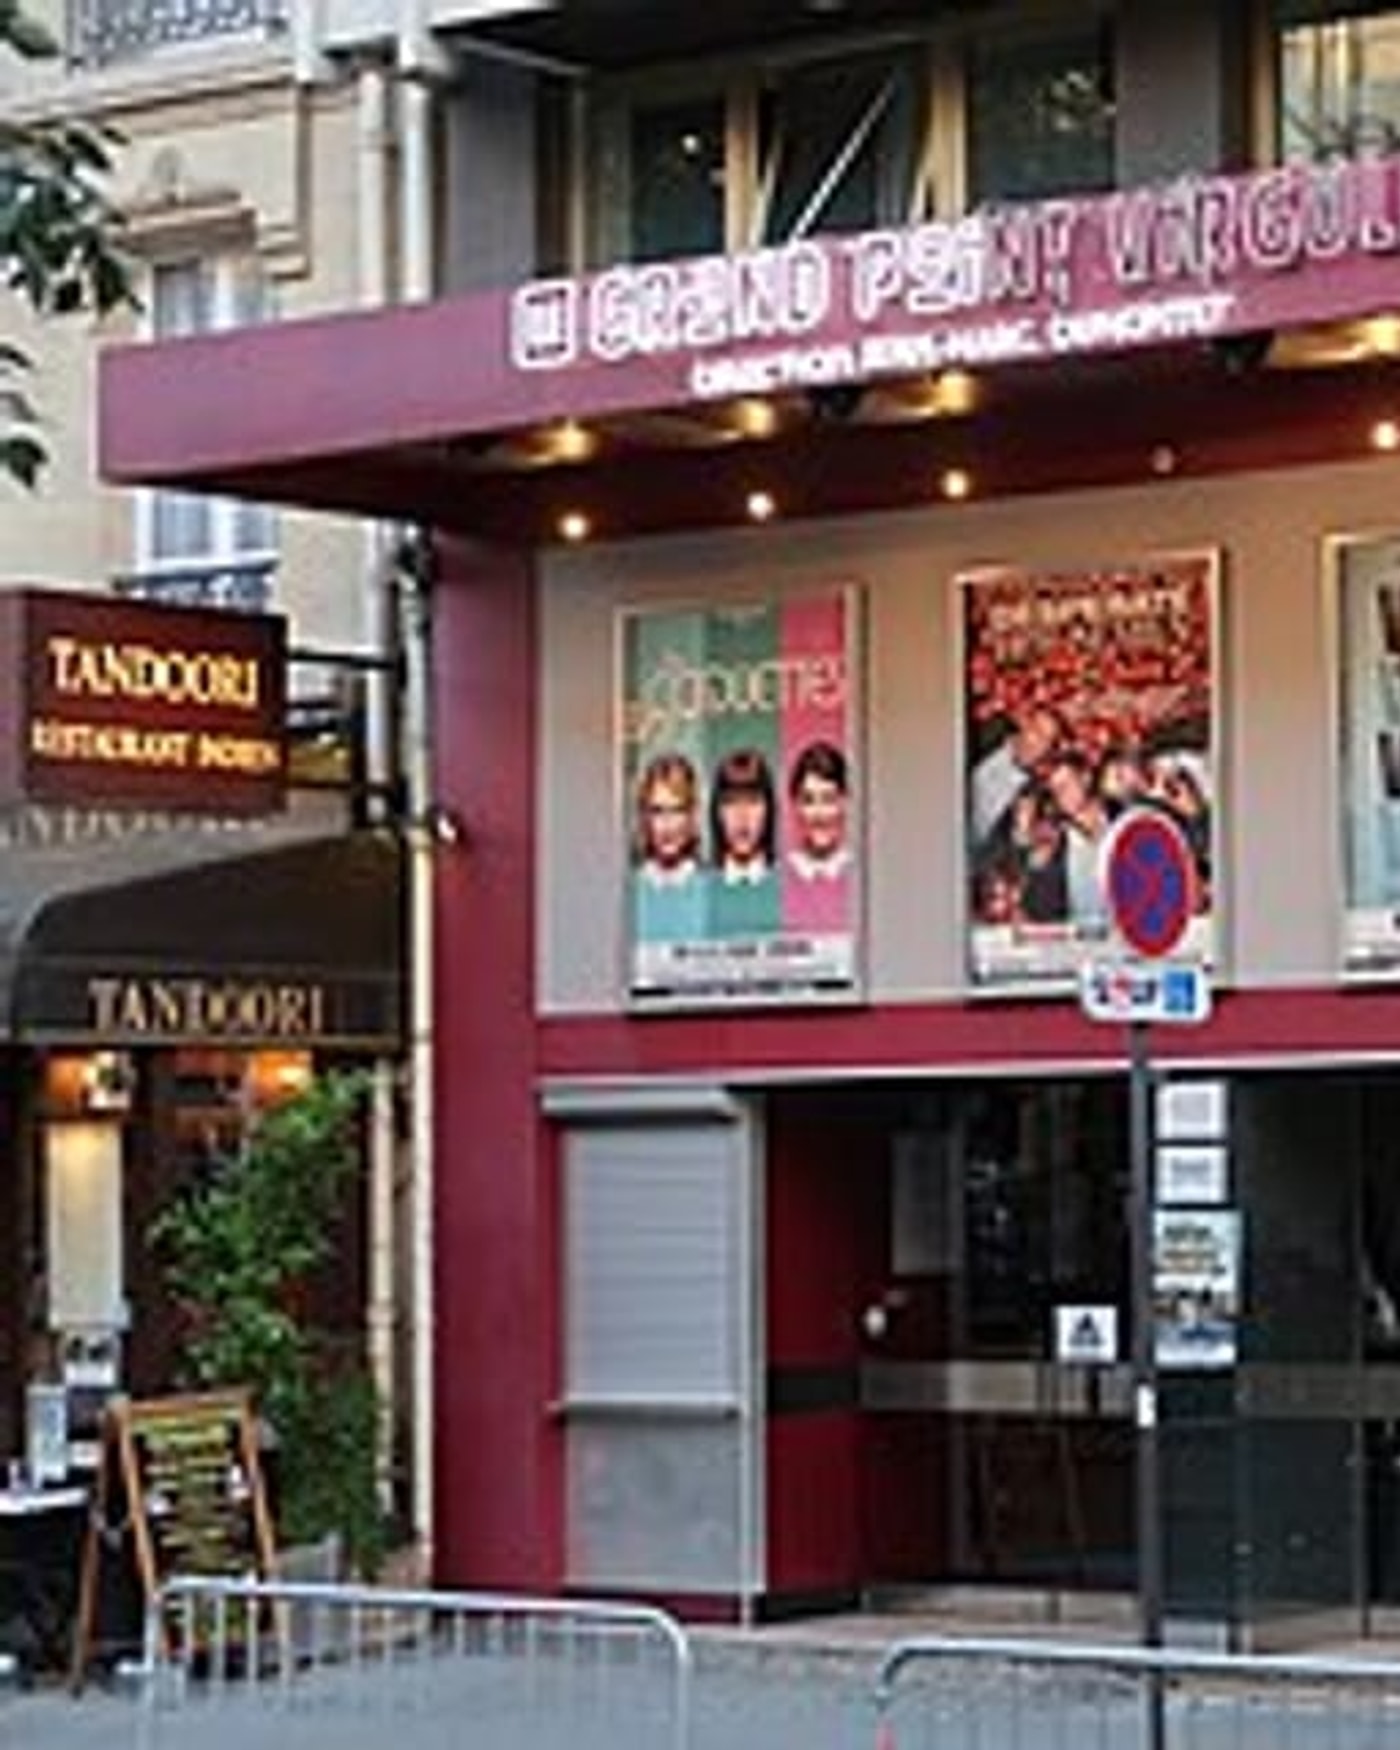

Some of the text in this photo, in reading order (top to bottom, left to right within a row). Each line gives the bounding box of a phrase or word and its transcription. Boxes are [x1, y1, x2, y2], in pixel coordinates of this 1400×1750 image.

[589, 241, 830, 361] GRAND
[46, 637, 259, 707] TANDOORI
[88, 978, 327, 1036] TANDOORI
